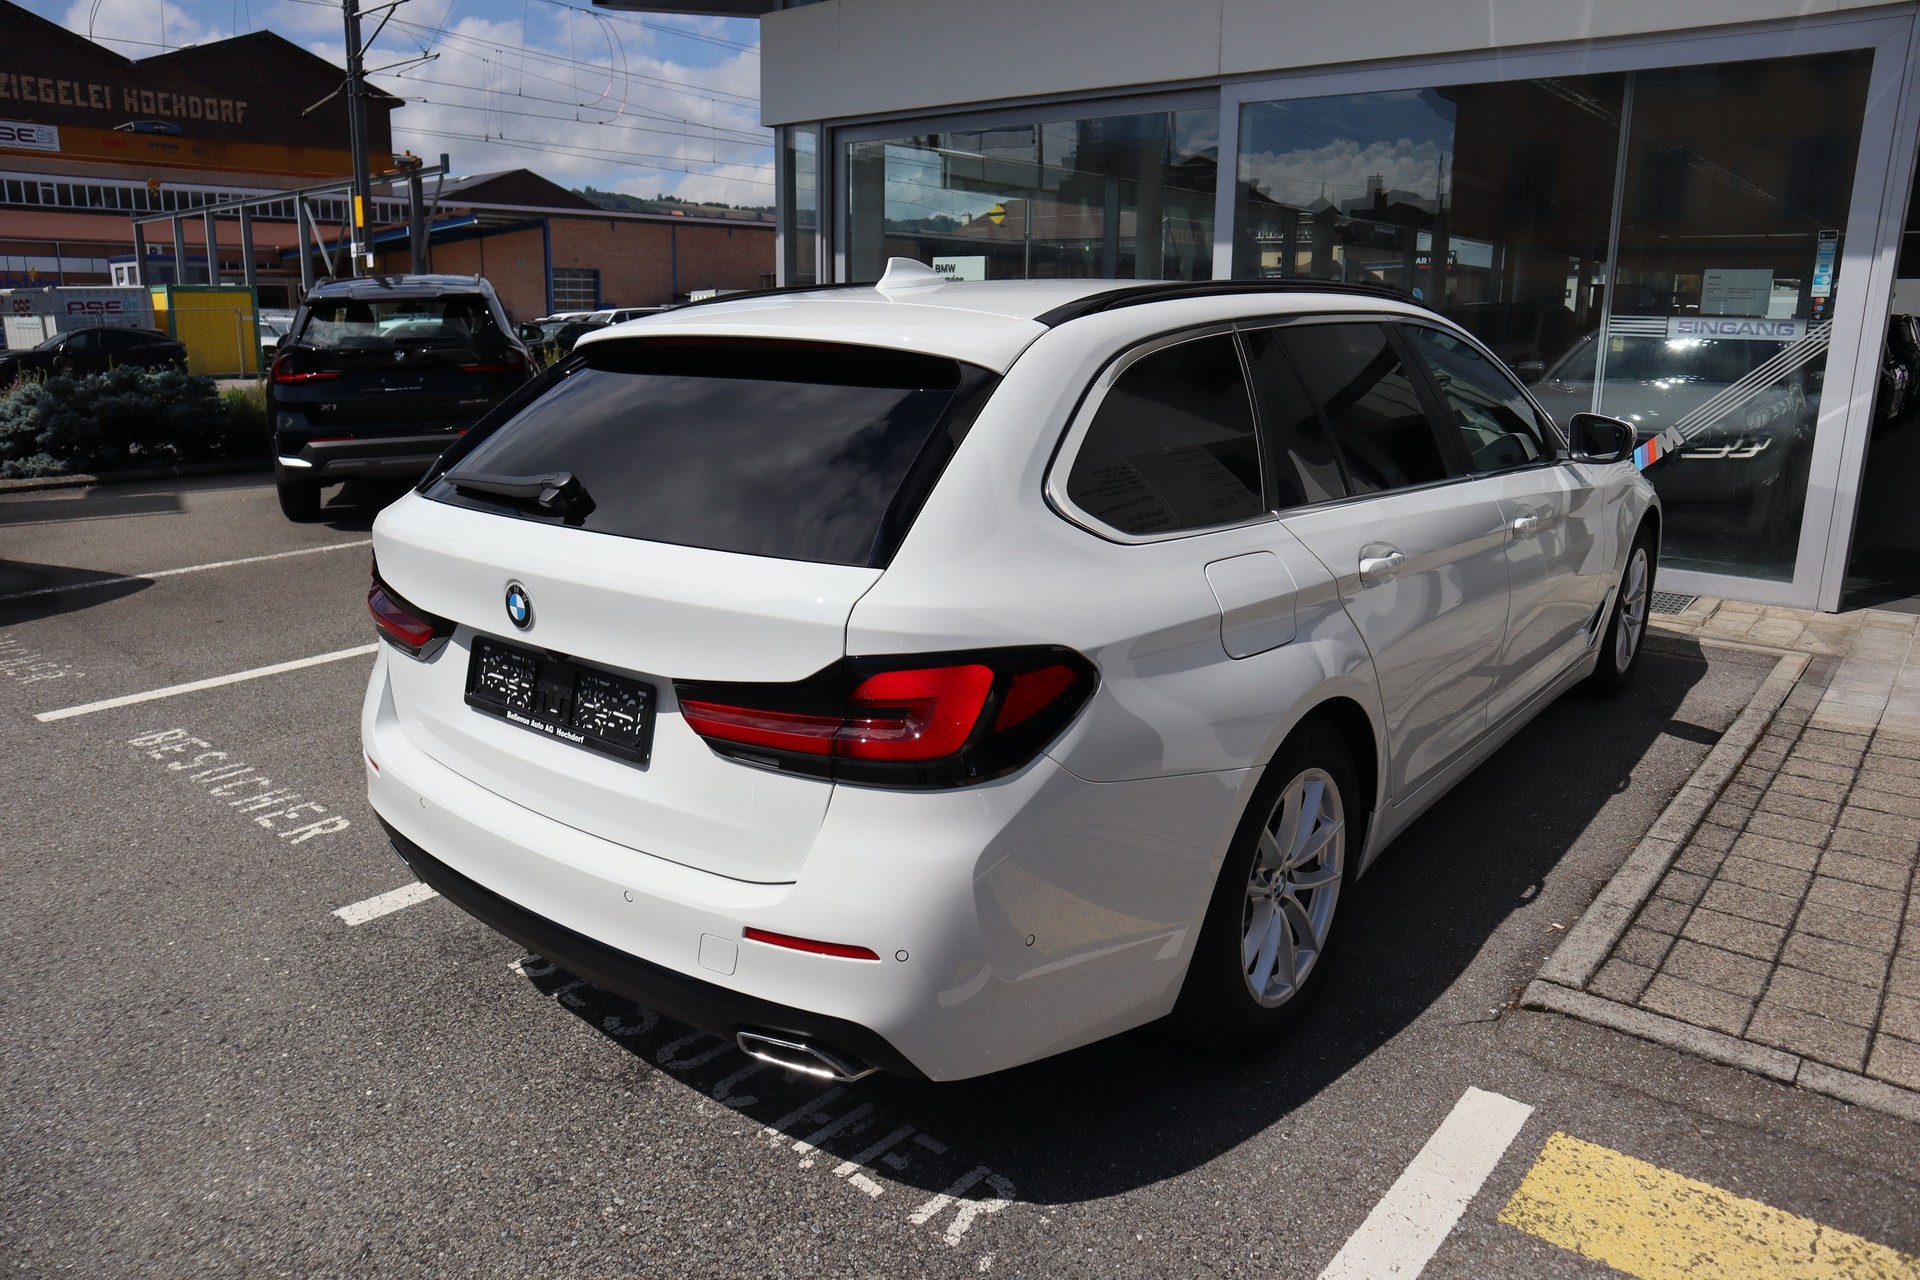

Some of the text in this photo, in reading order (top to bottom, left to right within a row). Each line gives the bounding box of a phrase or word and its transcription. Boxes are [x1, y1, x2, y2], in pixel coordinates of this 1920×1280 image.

[123, 88, 248, 124] HOCHDORF
[935, 264, 956, 273] BMW
[66, 300, 123, 315] ASE
[1677, 321, 1796, 337] EINGANG
[506, 710, 584, 744] Bellevue Auto AG Hochdorf
[128, 728, 351, 845] BESUCHER
